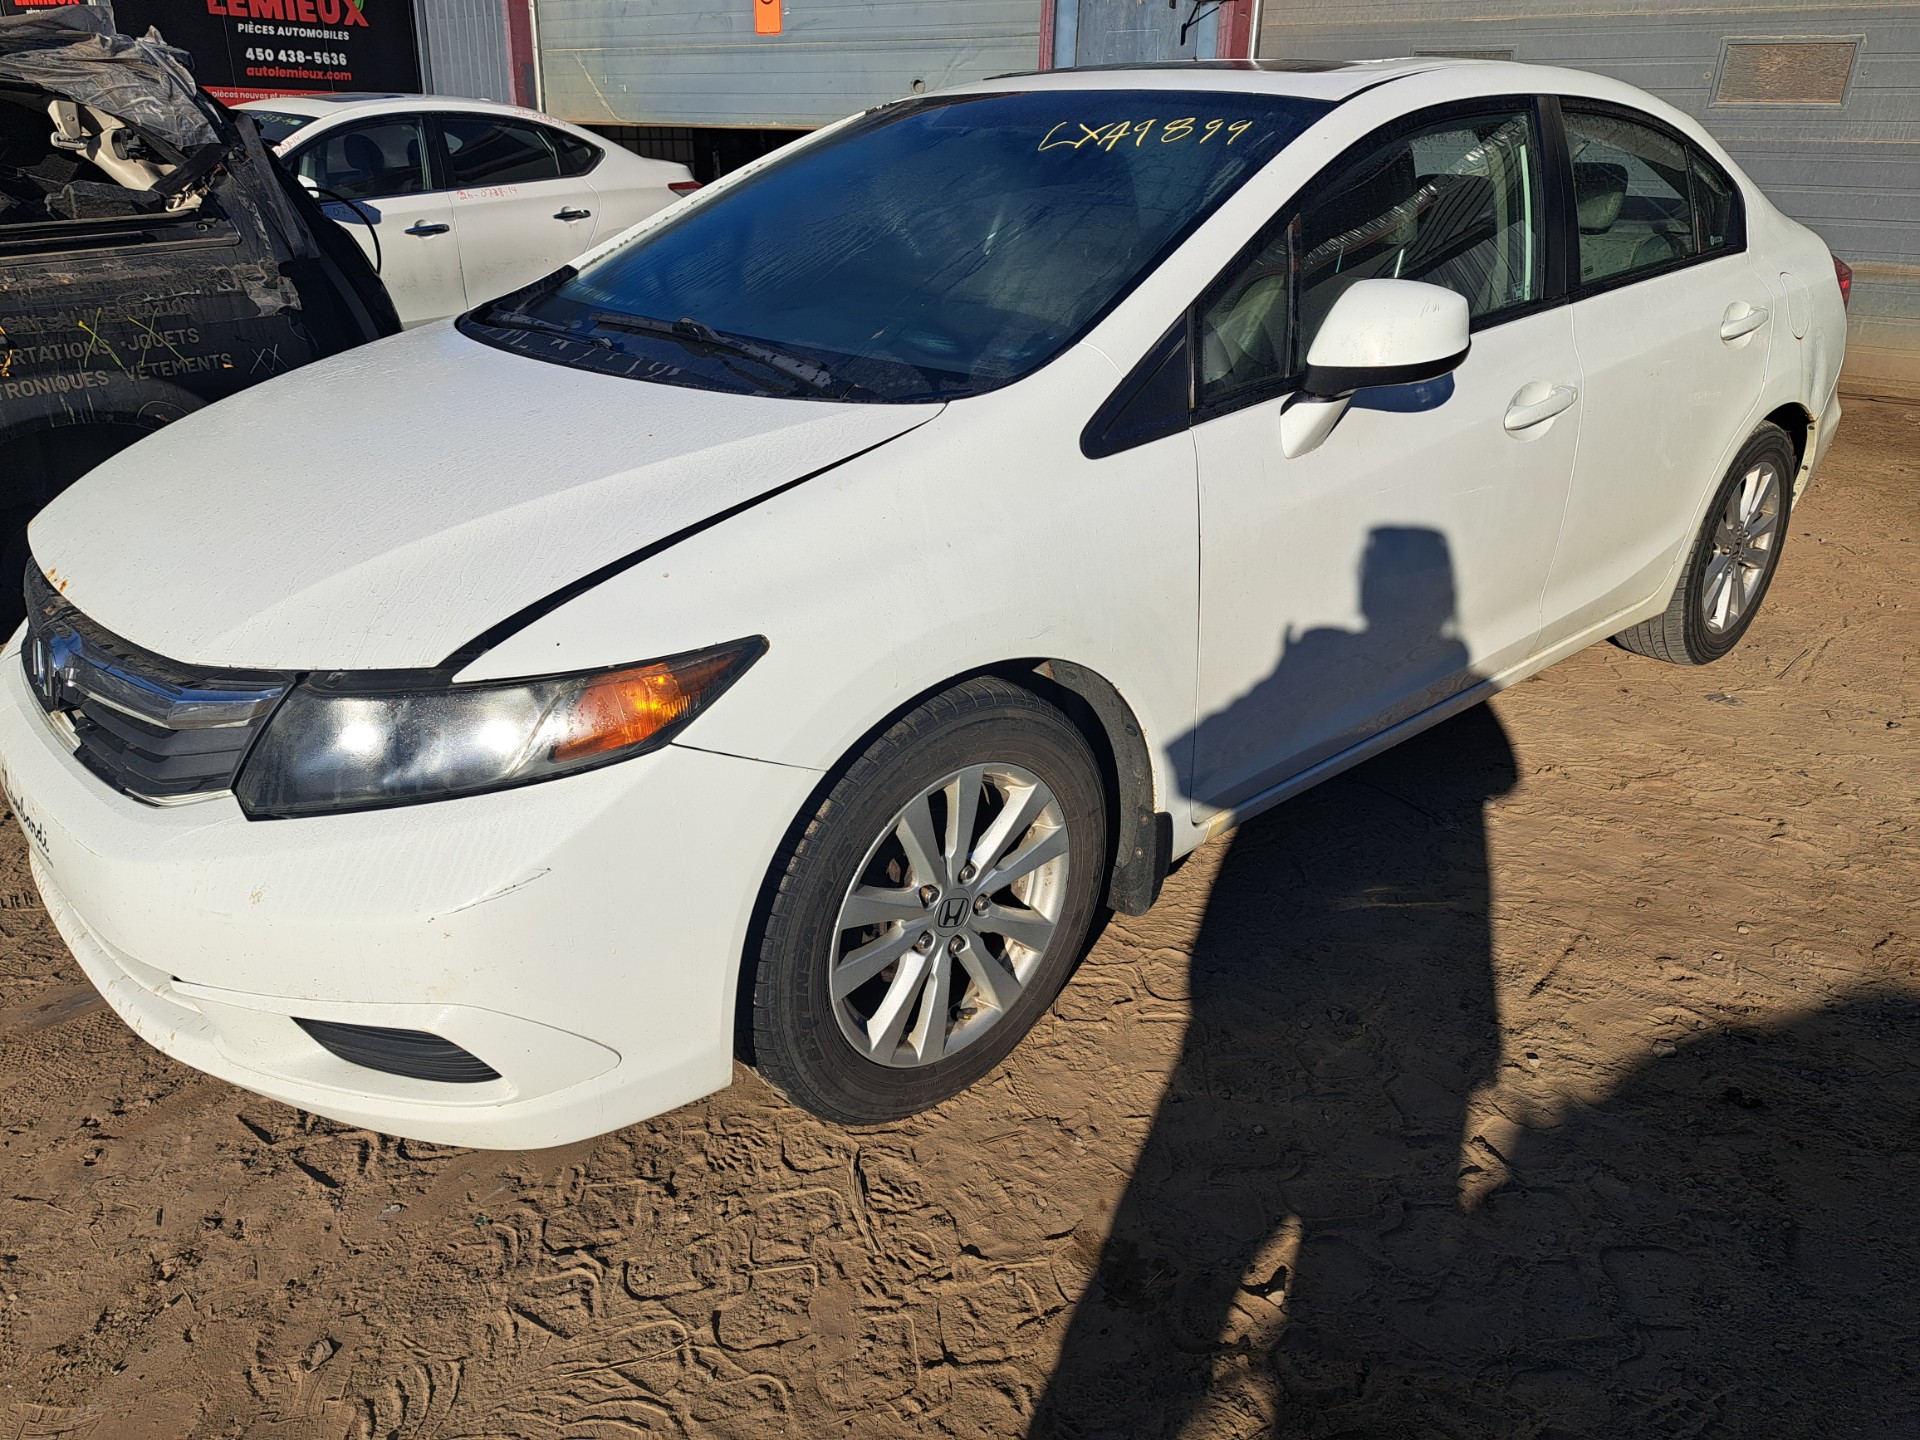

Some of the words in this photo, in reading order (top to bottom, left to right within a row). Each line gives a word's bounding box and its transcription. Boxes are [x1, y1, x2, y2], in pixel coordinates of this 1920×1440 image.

[206, 0, 369, 27] LEMIEUX
[237, 21, 275, 35] PIÈCES
[277, 25, 350, 40] AUTOMOBILES
[246, 48, 274, 61] 450
[278, 50, 347, 65] 438-5636
[247, 66, 352, 80] autolemieux.com
[212, 90, 239, 98] pièces
